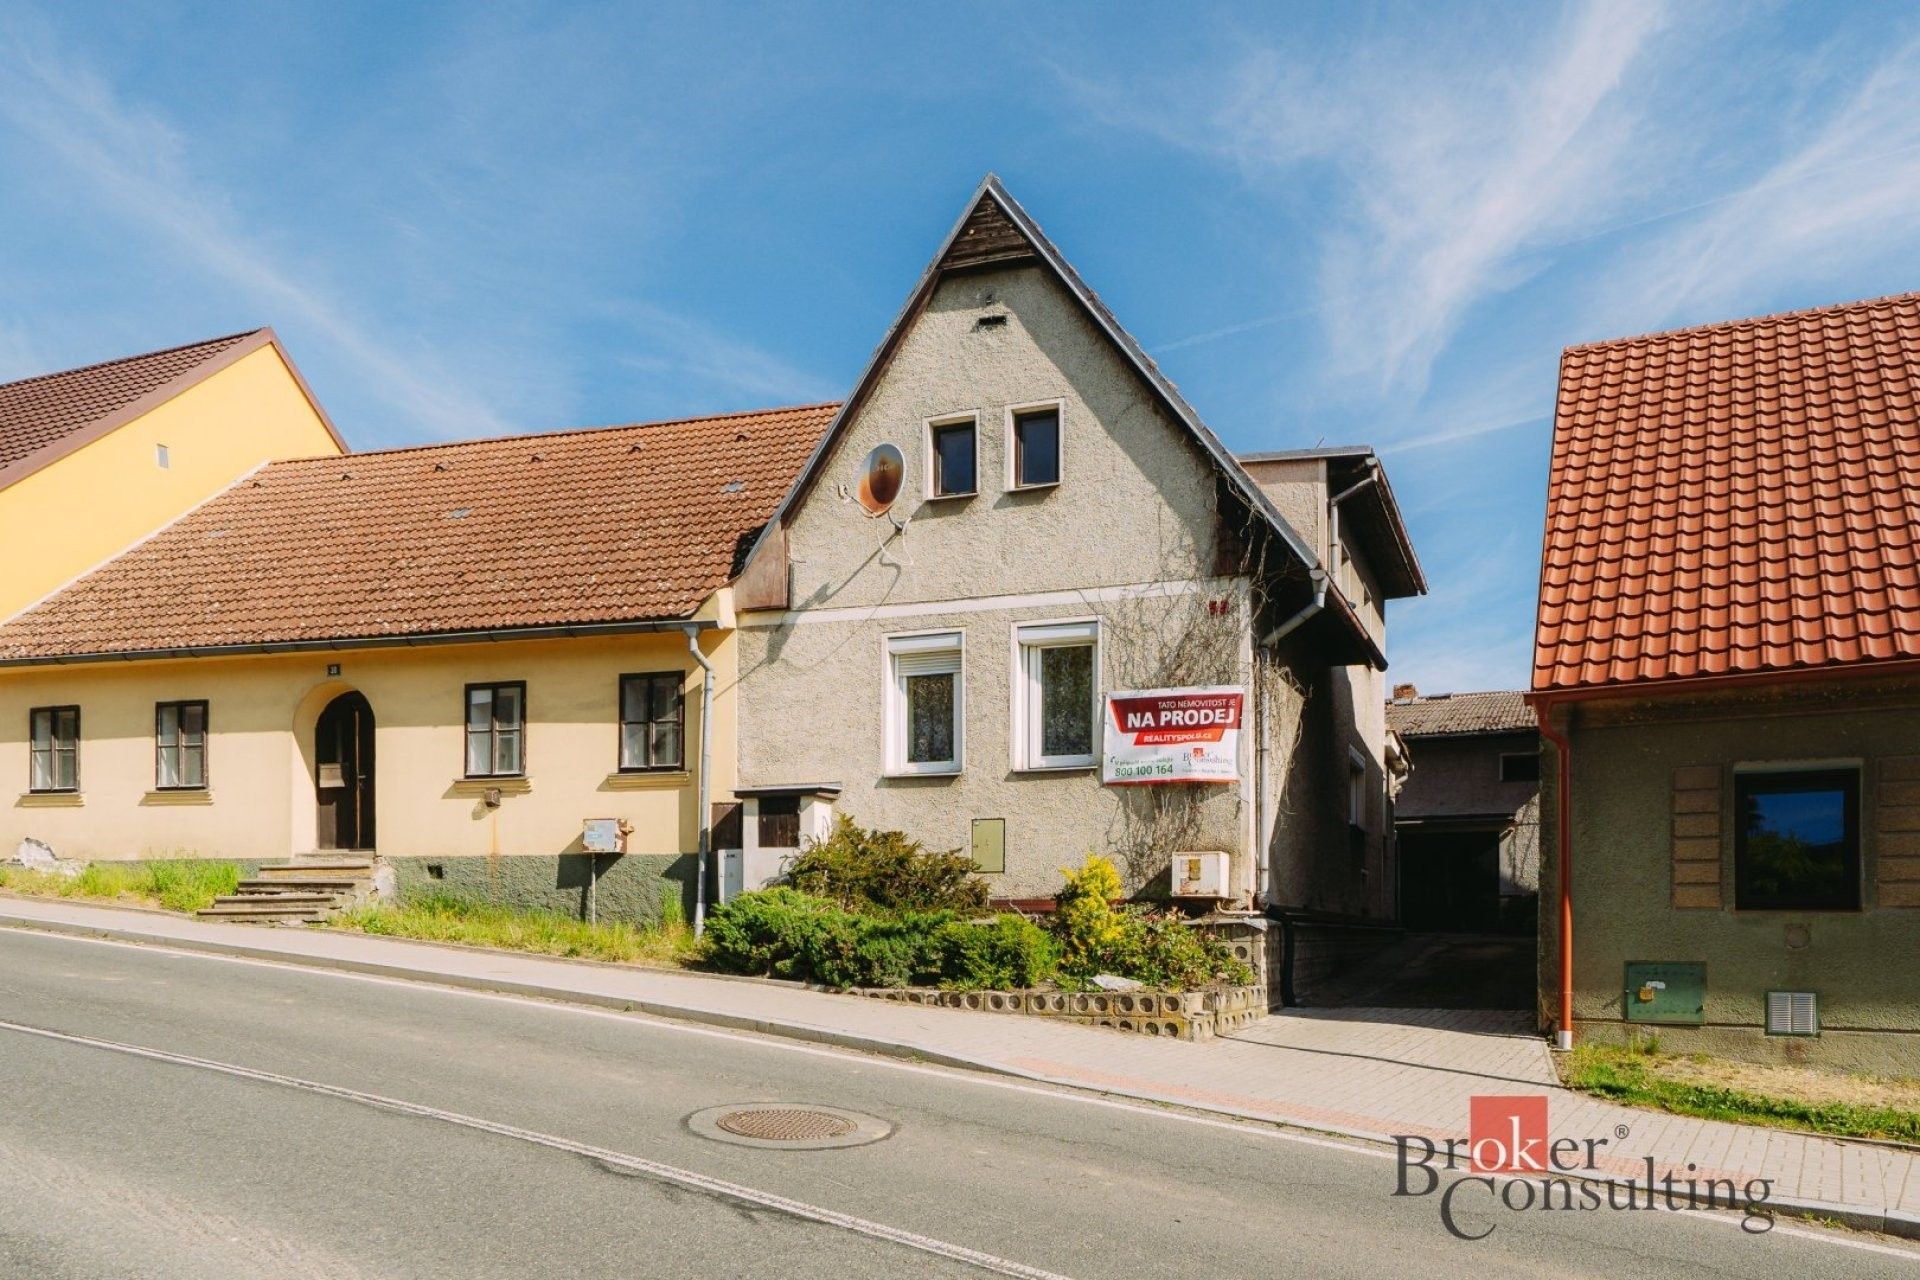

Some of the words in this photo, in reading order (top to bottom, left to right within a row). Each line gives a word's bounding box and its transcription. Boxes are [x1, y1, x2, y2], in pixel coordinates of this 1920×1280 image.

[1158, 701, 1176, 709] TATO
[1178, 699, 1226, 708] NEMOVITOST
[1127, 712, 1155, 728] NA
[1160, 708, 1235, 726] PRODEJ
[1115, 767, 1133, 777] 800
[1136, 766, 1153, 775] 100
[1156, 764, 1173, 774] 164
